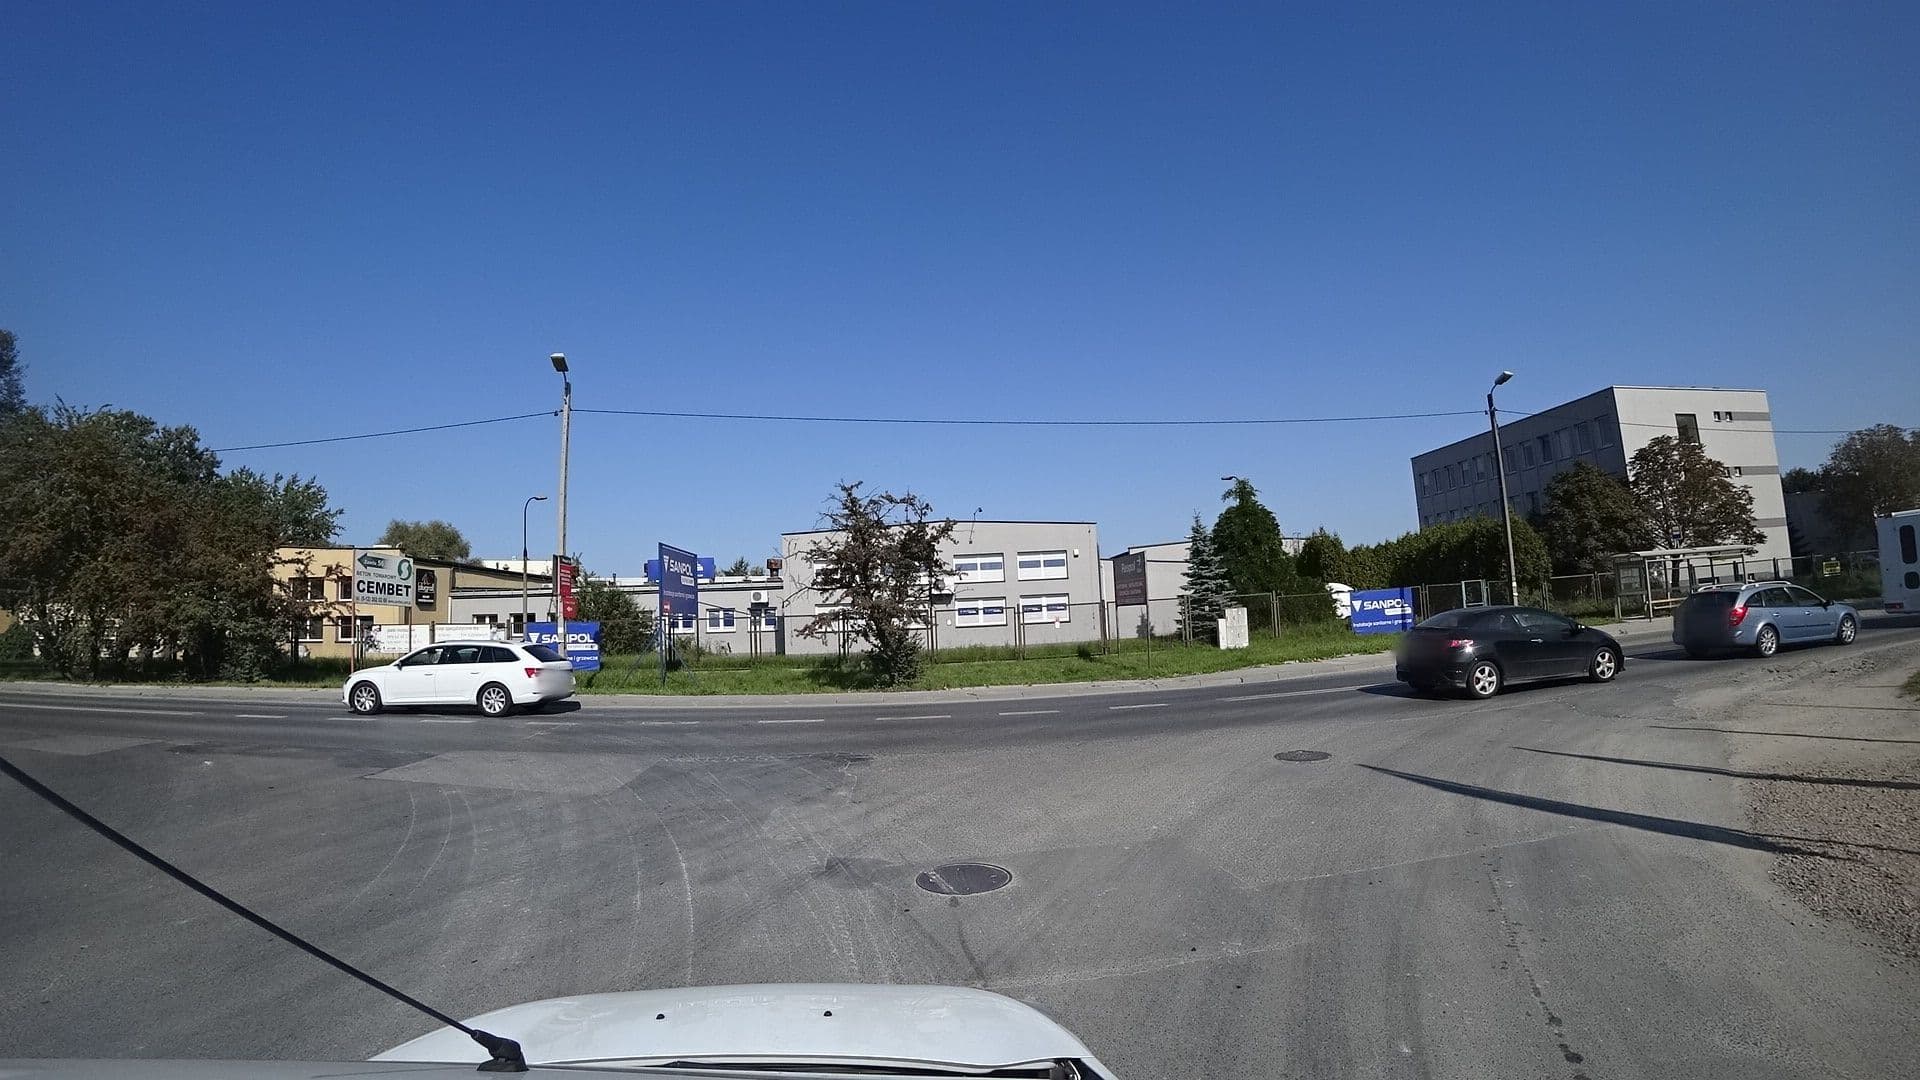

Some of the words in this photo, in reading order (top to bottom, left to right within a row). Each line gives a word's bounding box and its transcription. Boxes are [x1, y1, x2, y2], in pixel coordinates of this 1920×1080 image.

[669, 559, 694, 577] SANPOL
[356, 579, 412, 597] CEMBET
[1363, 598, 1409, 610] SANPOL
